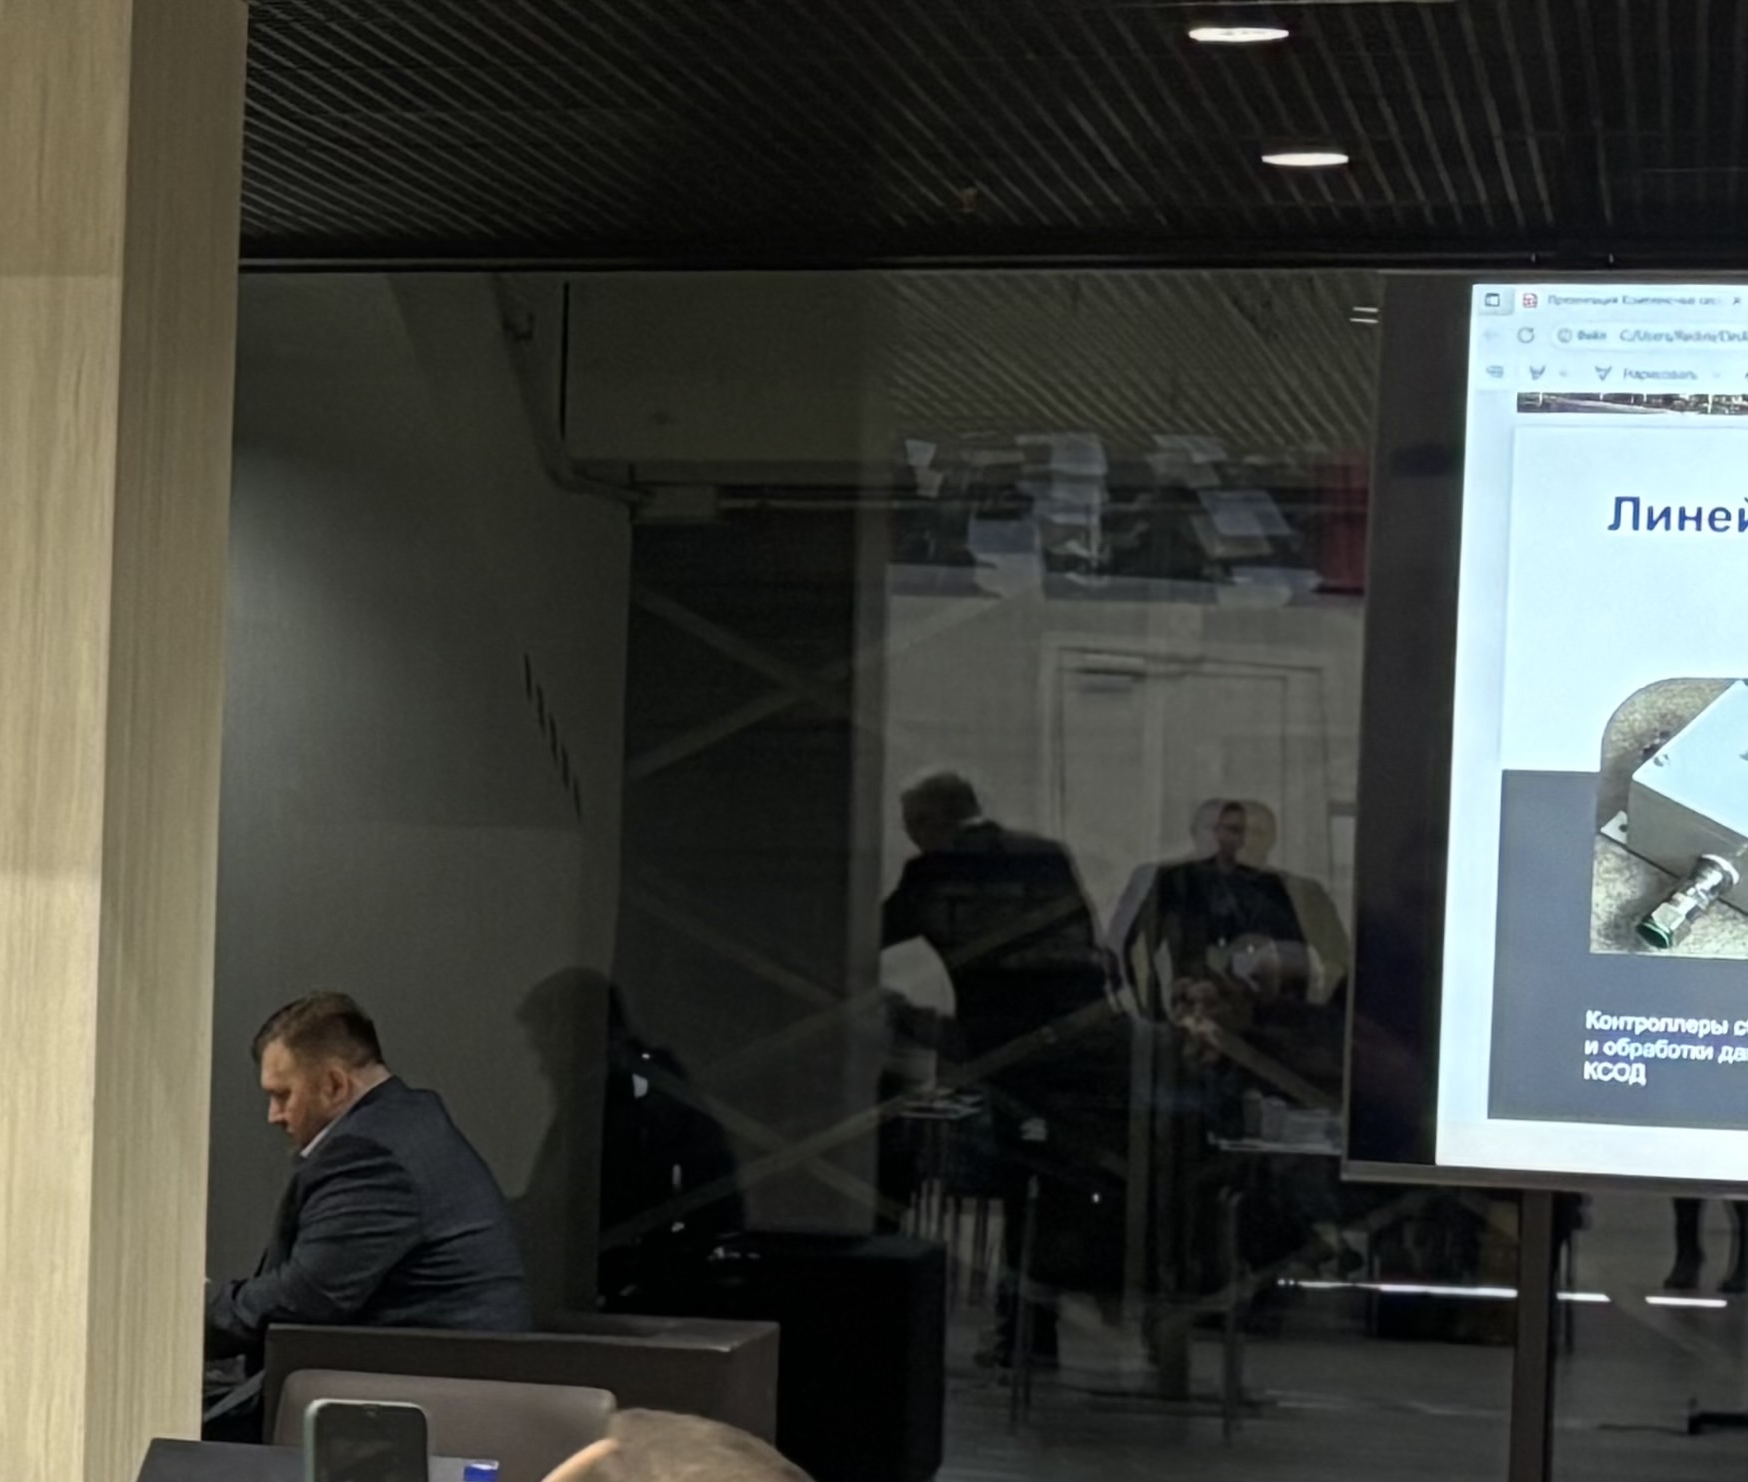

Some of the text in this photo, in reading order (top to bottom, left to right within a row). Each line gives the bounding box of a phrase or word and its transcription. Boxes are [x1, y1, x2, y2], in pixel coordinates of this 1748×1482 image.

[1585, 1009, 1729, 1039] Контроллеры
[1584, 1037, 1748, 1065] и обработки да
[1583, 1060, 1648, 1087] КСОД
